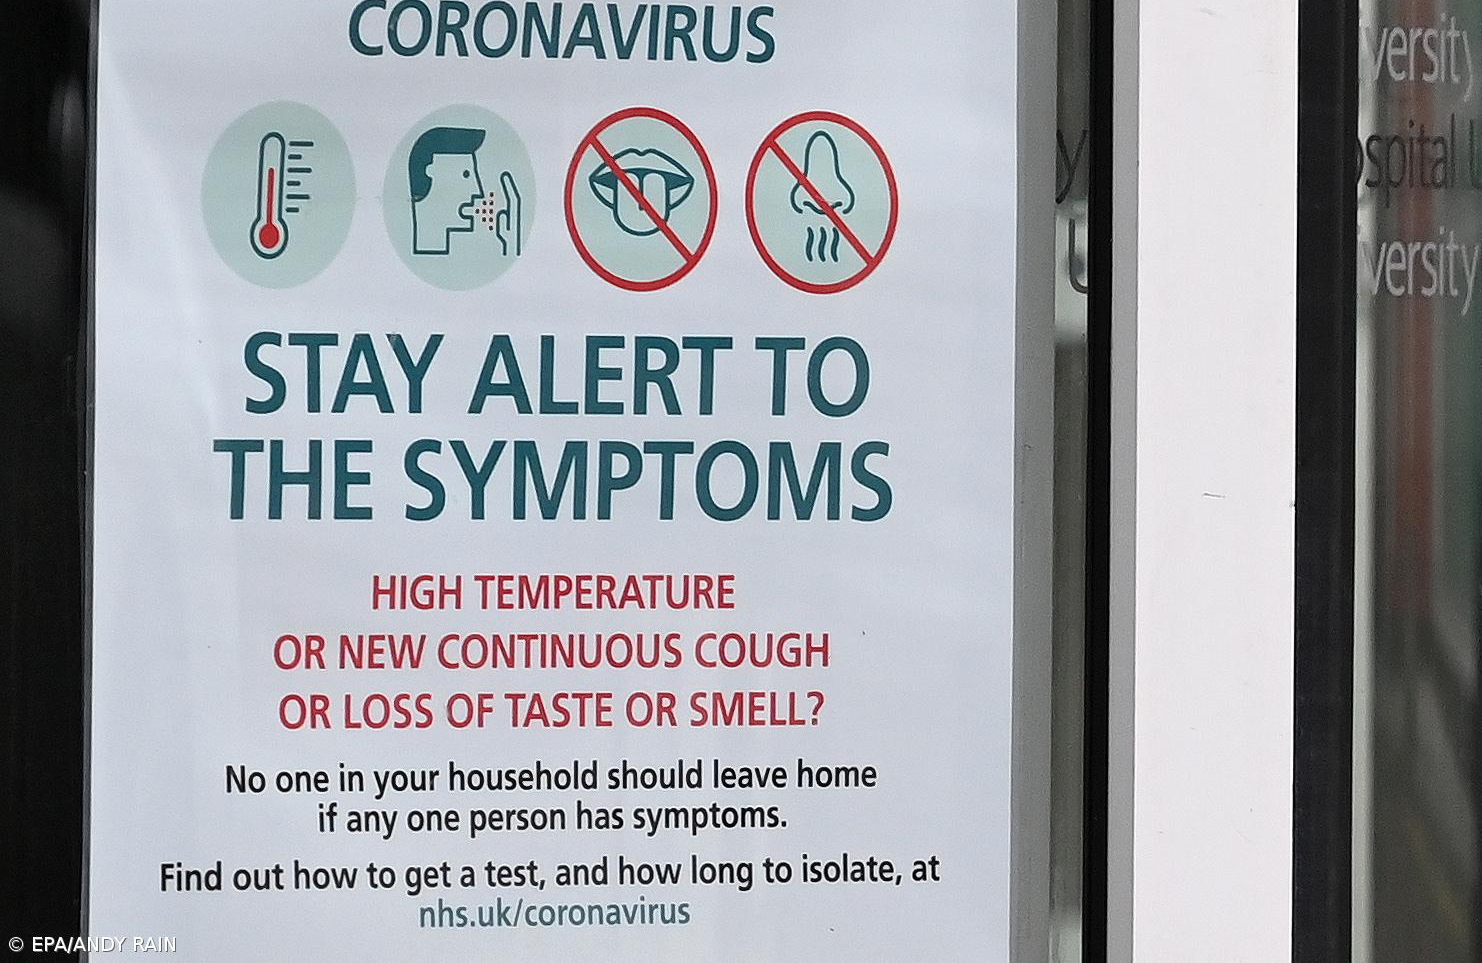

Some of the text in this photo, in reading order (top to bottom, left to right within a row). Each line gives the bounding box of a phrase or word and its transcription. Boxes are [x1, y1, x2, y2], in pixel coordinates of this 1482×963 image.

[243, 331, 871, 417] STAY ALERT TO
[212, 438, 893, 522] THE SYMPTOMS
[372, 573, 737, 610] HIGH TEMPERATURE
[273, 631, 829, 670] OR NEW CONTINUOUS COUGH
[278, 689, 826, 729] OR LOSS OF TASTE OR SMELL?
[225, 757, 878, 800] No one in your household should leave home
[318, 799, 787, 840] if any one person has symptoms.
[160, 852, 941, 896] Find out how to get a test, and how long to isolate, at
[418, 897, 691, 929] nhs.uk/coronavirus
